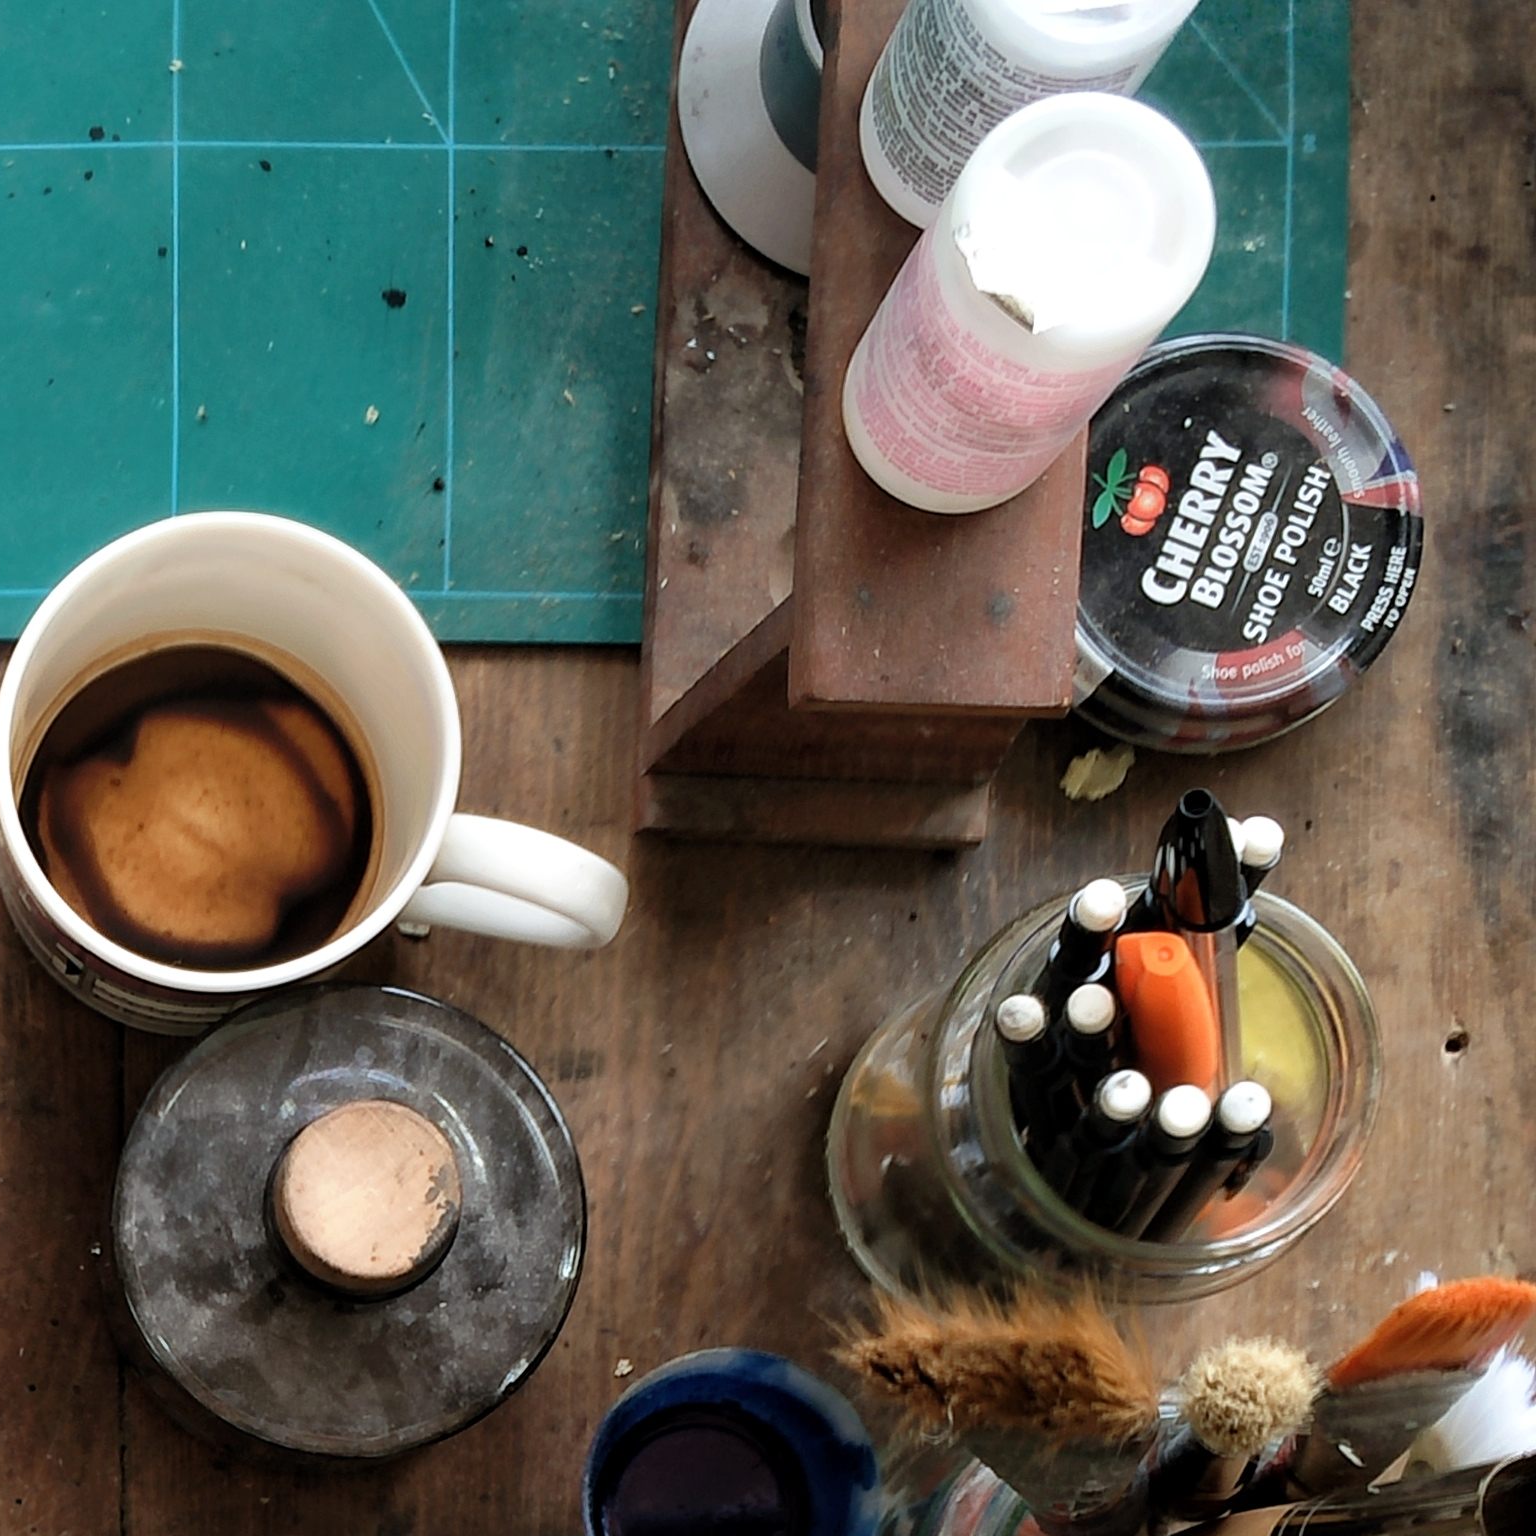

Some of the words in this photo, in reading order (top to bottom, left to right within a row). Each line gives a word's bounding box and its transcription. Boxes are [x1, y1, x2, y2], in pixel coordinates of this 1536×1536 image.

[1141, 430, 1242, 605] CHERRY
[1243, 567, 1290, 643] SHOE
[1273, 465, 1331, 565] POLISH
[1308, 555, 1335, 598] 50ml
[1328, 543, 1372, 615] BLACK
[1360, 586, 1394, 632] PRESS
[1384, 545, 1407, 585] HERE
[1383, 607, 1400, 629] TO
[1394, 567, 1416, 607] OPEN
[1242, 653, 1284, 680] polish
[1285, 641, 1306, 660] for
